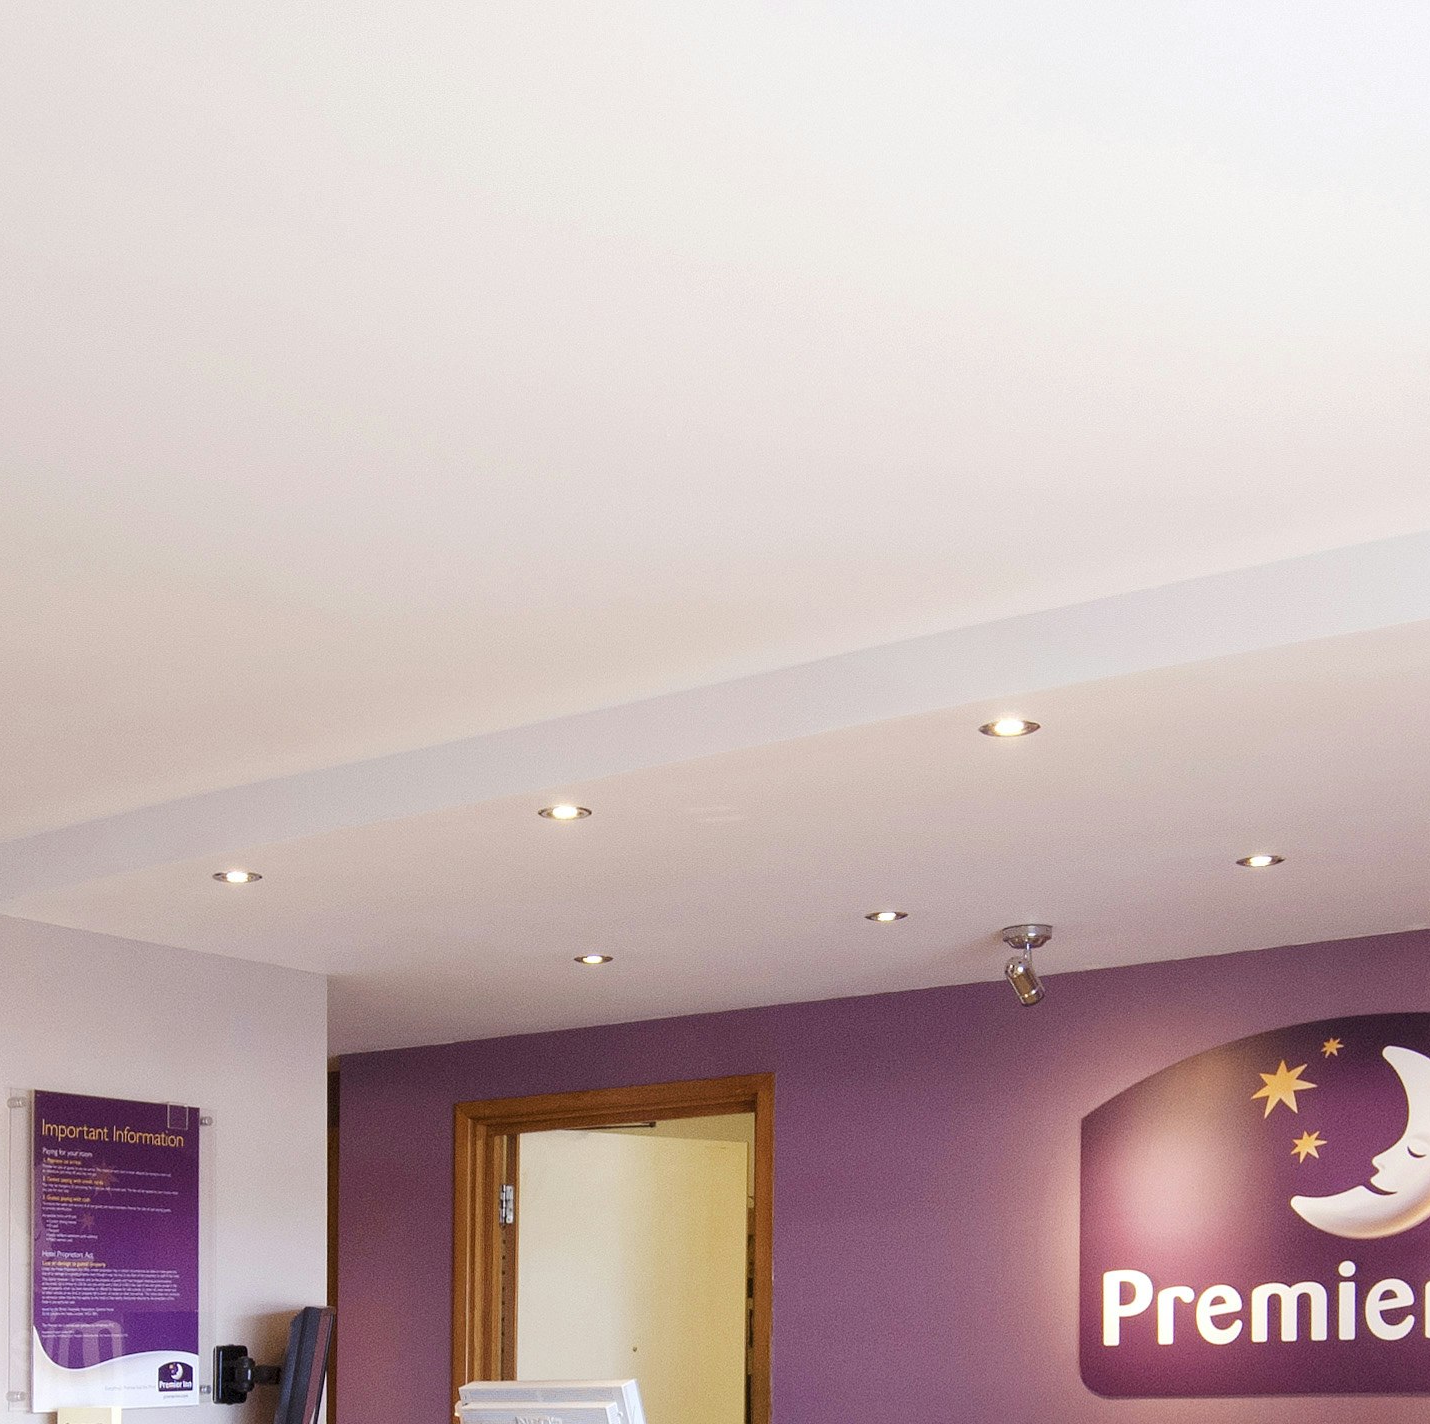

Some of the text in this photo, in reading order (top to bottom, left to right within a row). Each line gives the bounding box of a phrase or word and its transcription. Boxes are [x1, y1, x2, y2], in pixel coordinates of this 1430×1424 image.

[41, 1118, 185, 1147] Important Information
[159, 1380, 182, 1389] Premier
